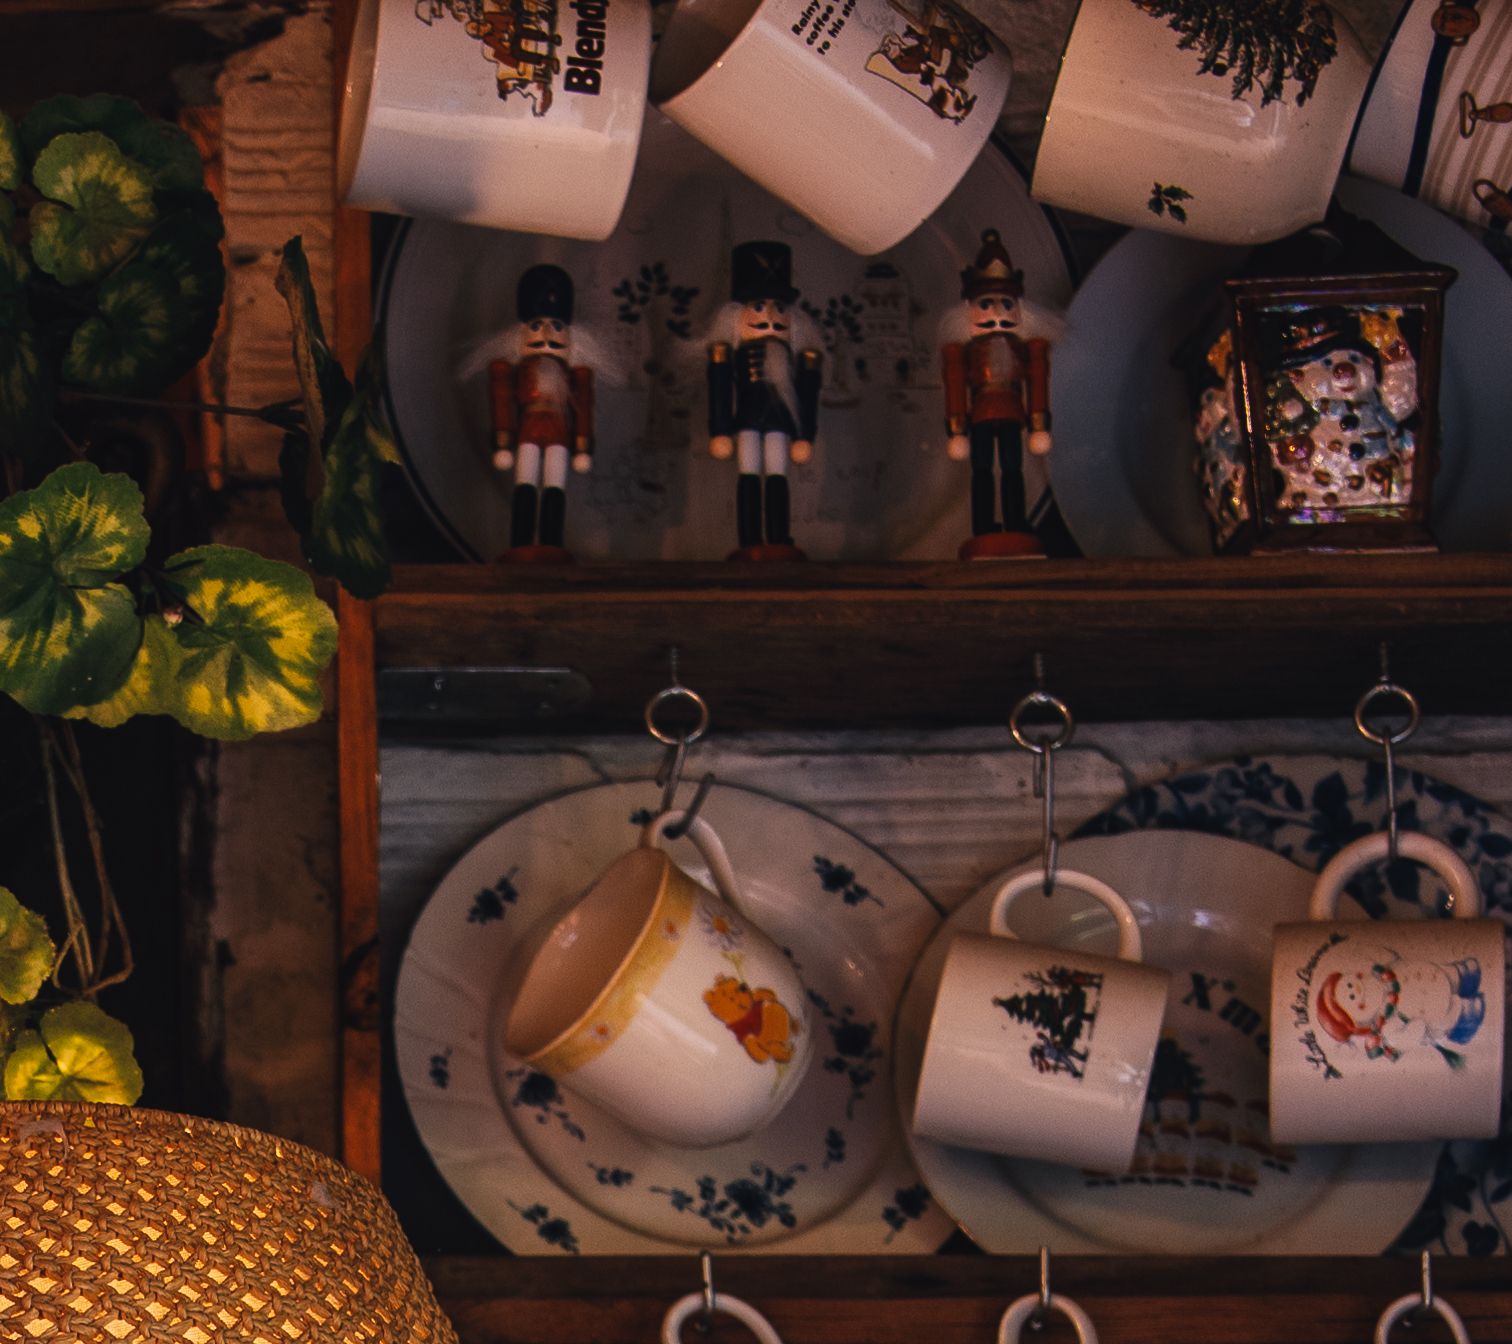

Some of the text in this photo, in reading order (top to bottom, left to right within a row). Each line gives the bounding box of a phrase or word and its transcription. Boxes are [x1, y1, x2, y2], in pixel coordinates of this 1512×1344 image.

[806, 4, 835, 46] coffee
[817, 40, 831, 56] to
[827, 18, 845, 39] his
[564, 0, 611, 95] Blend
